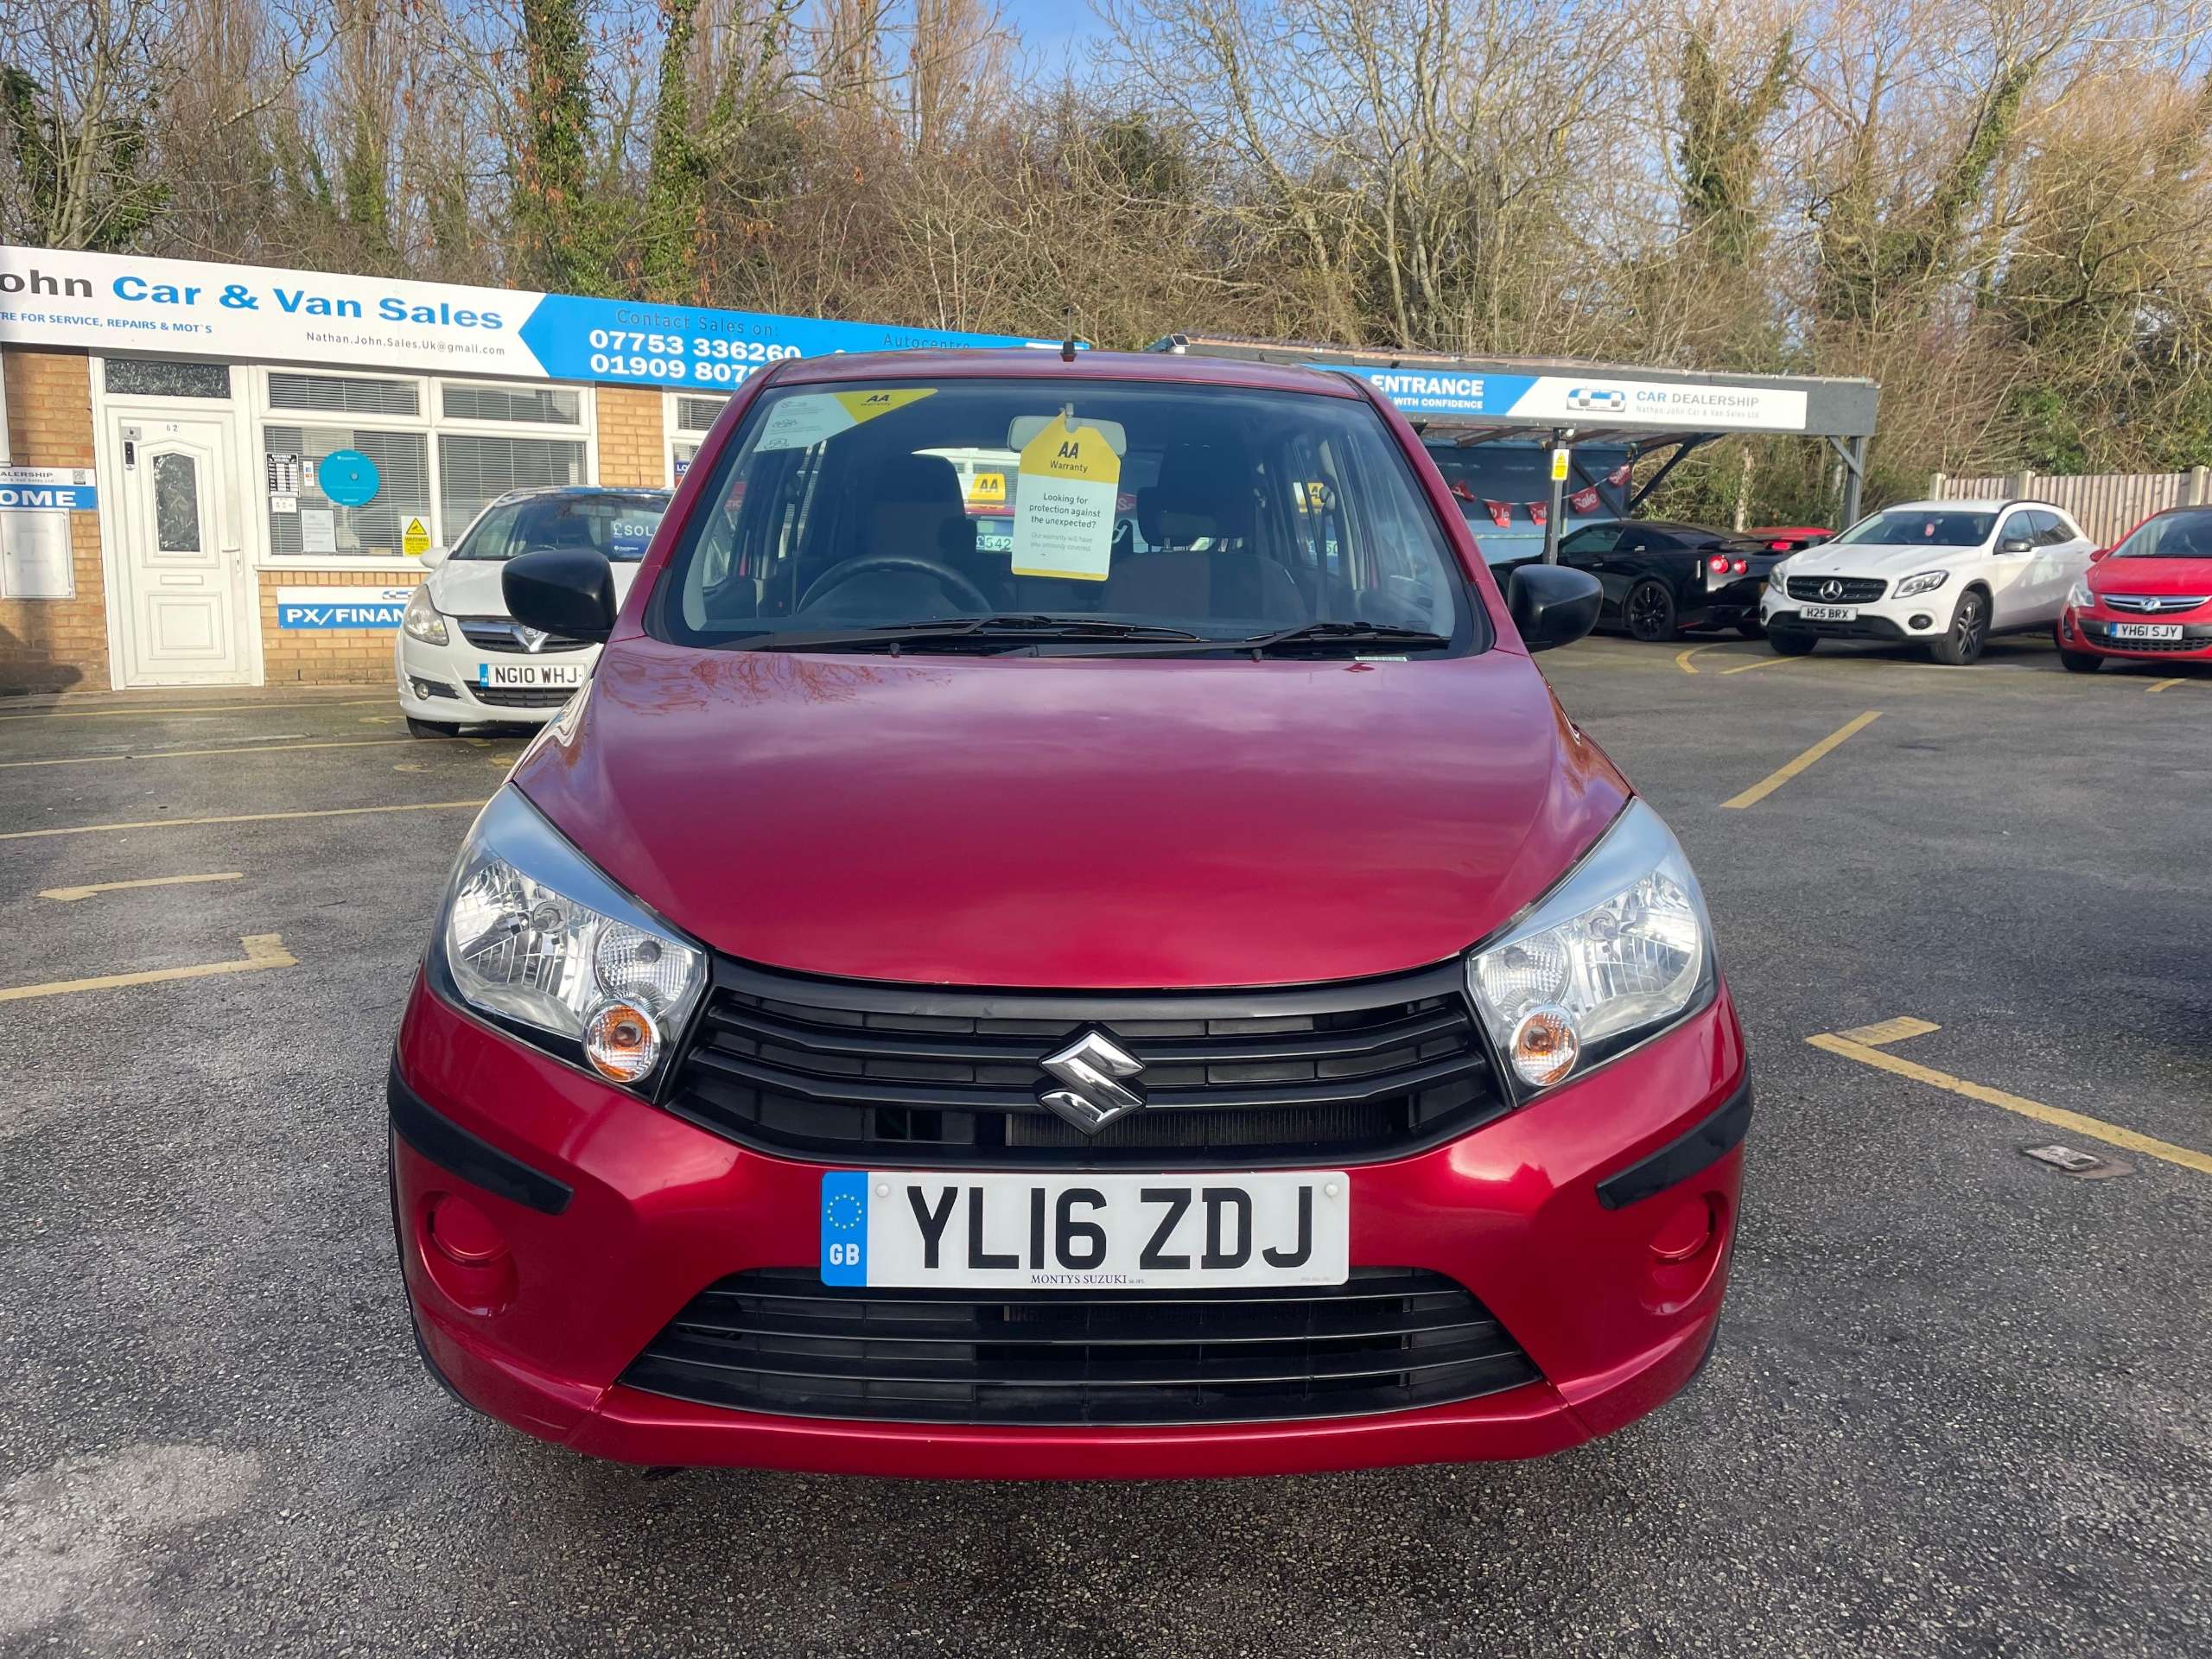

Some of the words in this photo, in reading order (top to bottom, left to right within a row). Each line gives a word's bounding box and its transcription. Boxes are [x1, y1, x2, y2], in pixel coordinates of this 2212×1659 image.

[112, 276, 200, 305] Car
[219, 284, 259, 309] &
[273, 289, 361, 318] Van
[378, 297, 503, 329] Sales
[0, 312, 16, 321] RE
[21, 313, 45, 323] FOR
[49, 315, 103, 327] SERVICE,
[107, 319, 156, 330] REPAIRS
[160, 322, 168, 331] &
[617, 309, 690, 328] Contact
[699, 317, 744, 334] Sales
[589, 329, 683, 354] 07753
[693, 338, 802, 362] 336260
[590, 353, 685, 378] 01909
[1370, 374, 1484, 397] ENTRANCE
[866, 394, 891, 403] AA
[1394, 397, 1419, 406] WITH
[1421, 398, 1484, 409] CONFIDENCE
[1637, 391, 1667, 403] CAR
[1672, 393, 1759, 407] DEALERSHIP
[1058, 442, 1079, 459] AA
[1051, 461, 1088, 474] Warranty
[980, 479, 998, 492] AA
[0, 489, 77, 506] OME
[1043, 493, 1074, 505] Looking
[1077, 494, 1089, 504] for
[1573, 493, 1597, 508] Sale
[1029, 505, 1069, 514] protection
[1071, 507, 1100, 518] against
[1045, 518, 1096, 529] unexpected?
[1807, 607, 1826, 617] H25
[1828, 608, 1849, 619] BRX
[2122, 624, 2149, 636] YH61
[2152, 626, 2177, 637] SJY
[495, 667, 535, 683] NG10
[542, 667, 577, 683] WHJ
[906, 1185, 1107, 1270] YL16
[1139, 1185, 1313, 1270] ZDJ
[830, 1243, 860, 1266] GB
[1031, 1274, 1080, 1284] MONTYS
[1083, 1274, 1128, 1284] SUZUKI
